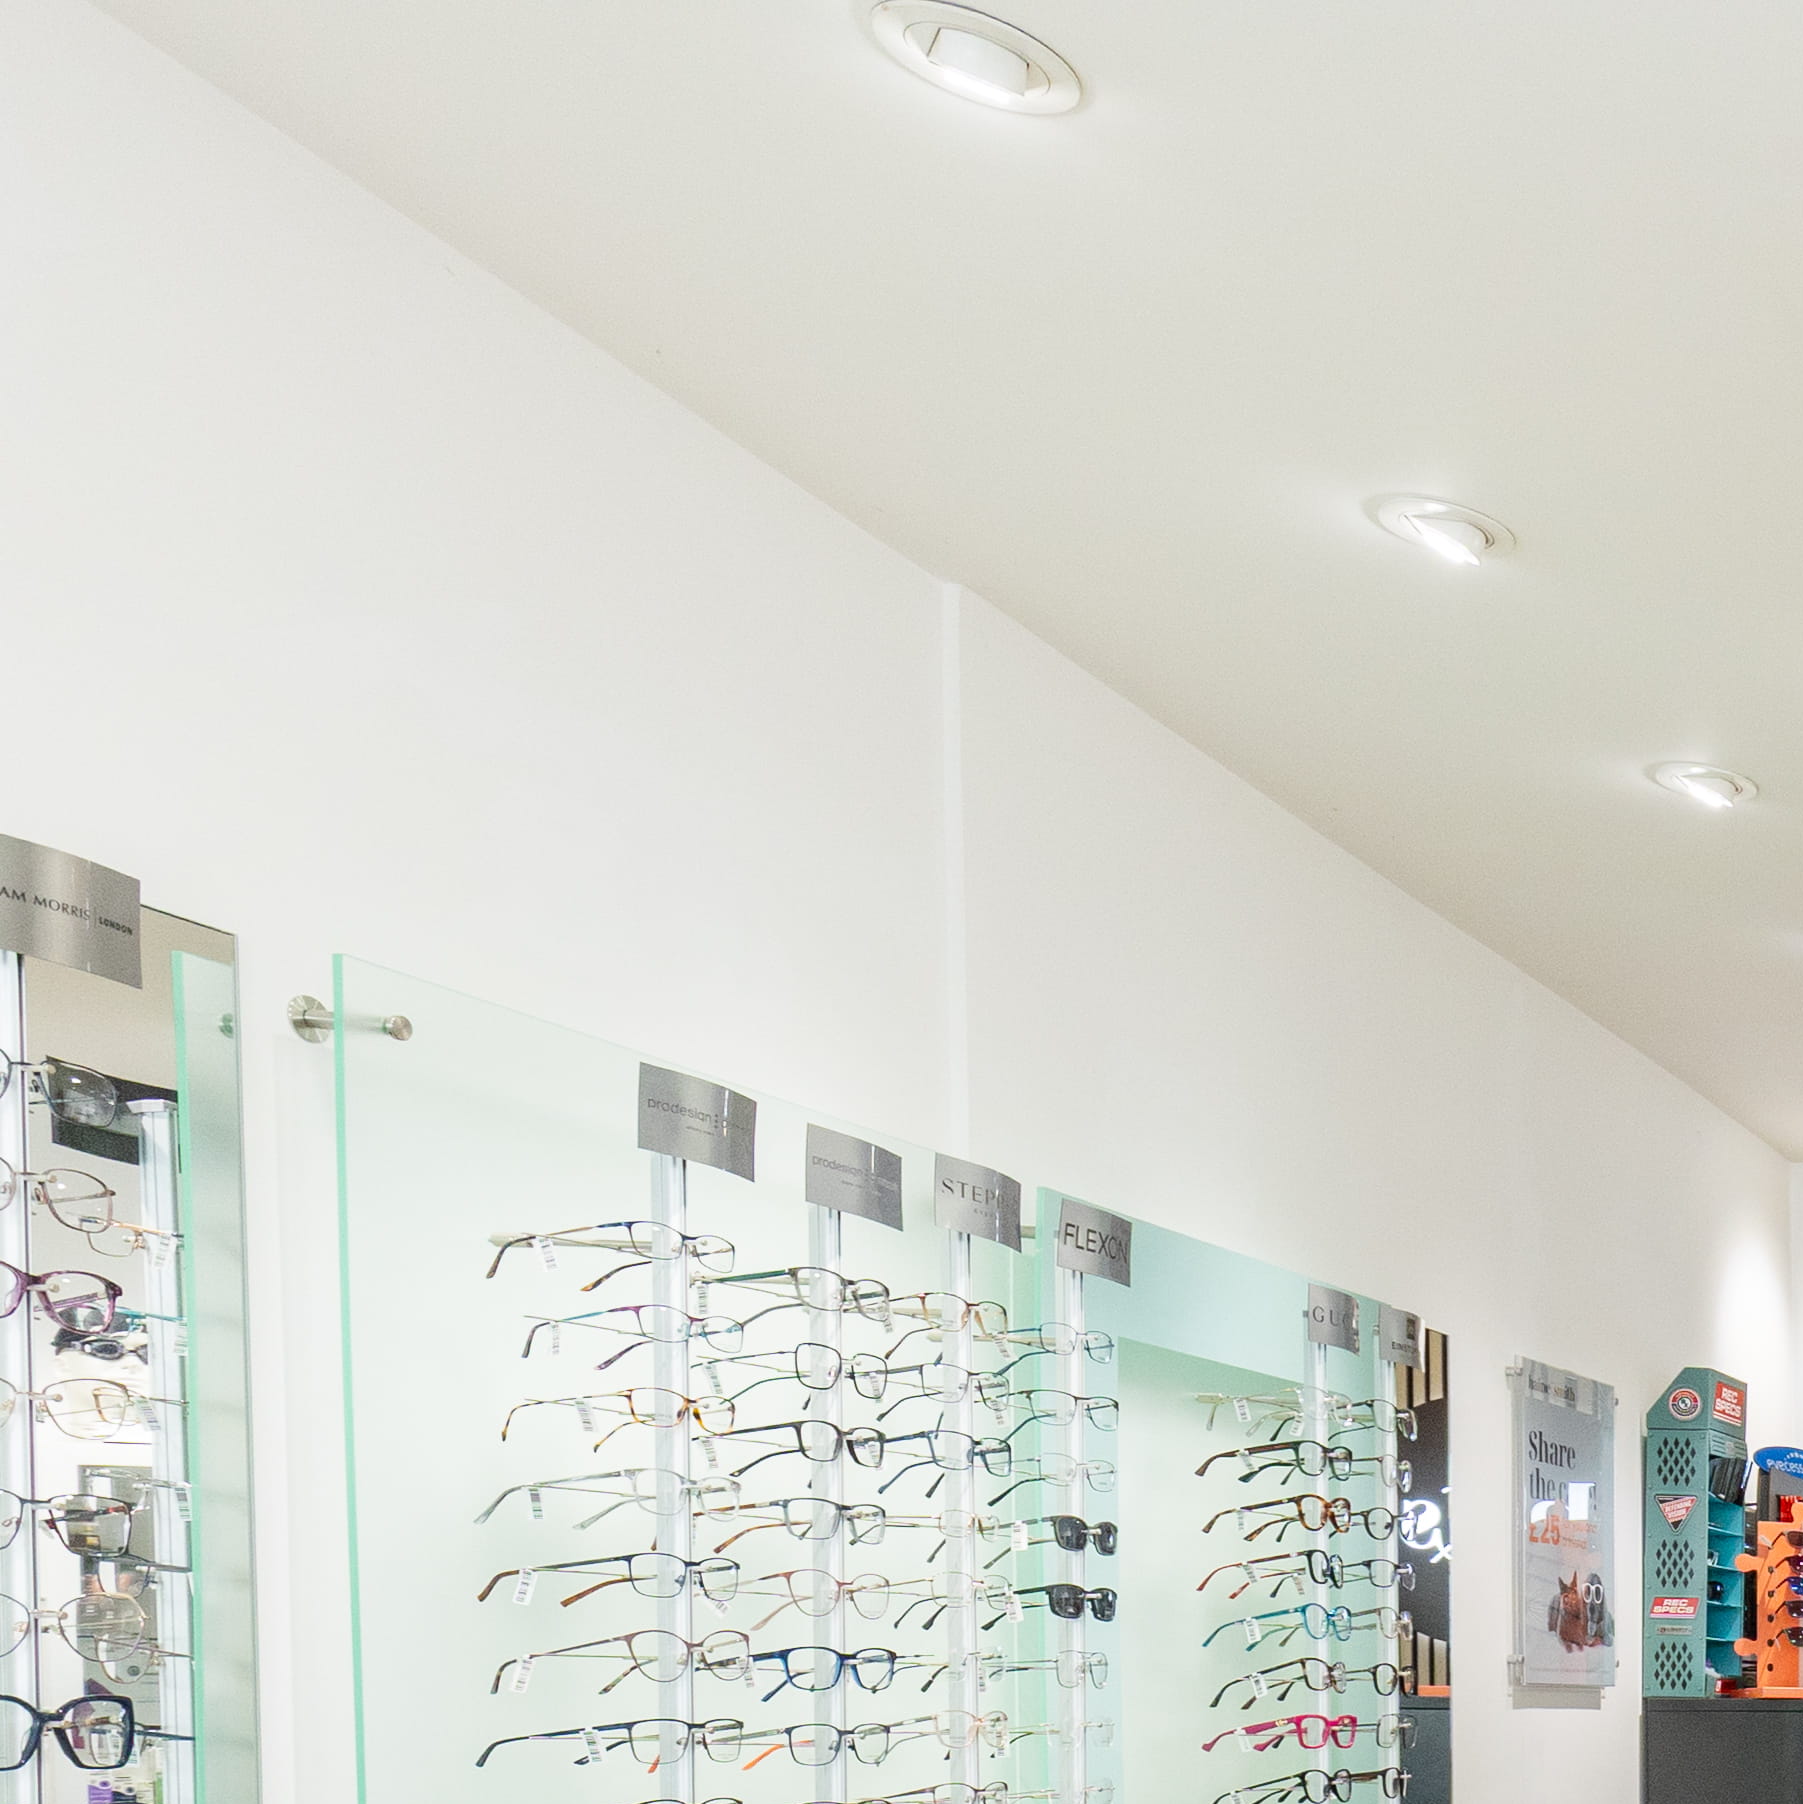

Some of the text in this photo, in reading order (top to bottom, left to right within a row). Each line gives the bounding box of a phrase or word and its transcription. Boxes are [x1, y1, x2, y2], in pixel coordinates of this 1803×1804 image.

[33, 896, 91, 921] MORRIS
[98, 916, 133, 936] LONDON
[1063, 1222, 1128, 1265] FLEXON
[1715, 1398, 1742, 1417] SPECS
[1721, 1387, 1738, 1403] REC
[1528, 1430, 1576, 1470] Share
[1529, 1467, 1555, 1500] the
[1653, 1606, 1695, 1614] SPECS
